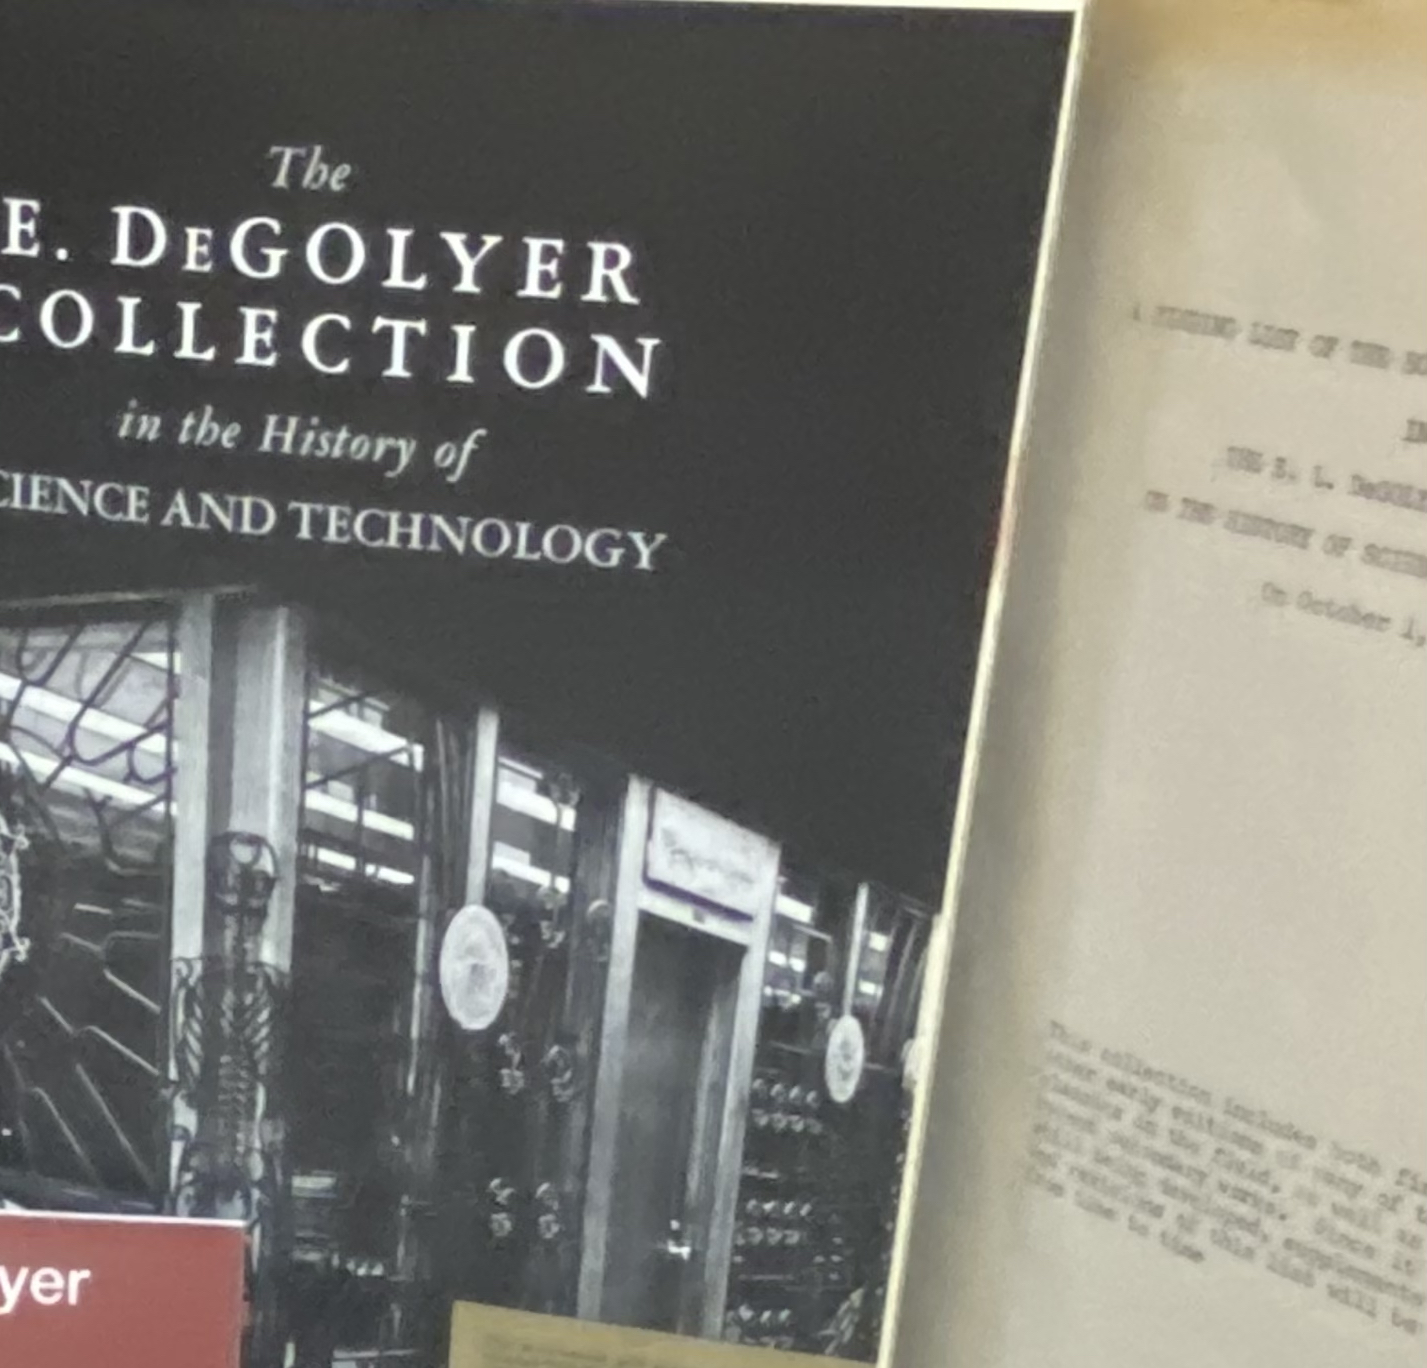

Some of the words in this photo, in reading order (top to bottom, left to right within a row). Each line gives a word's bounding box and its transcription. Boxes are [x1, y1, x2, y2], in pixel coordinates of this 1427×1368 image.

[268, 146, 355, 193] The
[1, 198, 71, 262] E.
[116, 401, 164, 443] in
[179, 404, 242, 453] the
[258, 415, 419, 478] History
[433, 429, 488, 483] of
[160, 492, 277, 537] AND
[286, 501, 668, 573] TECHNOLOGY
